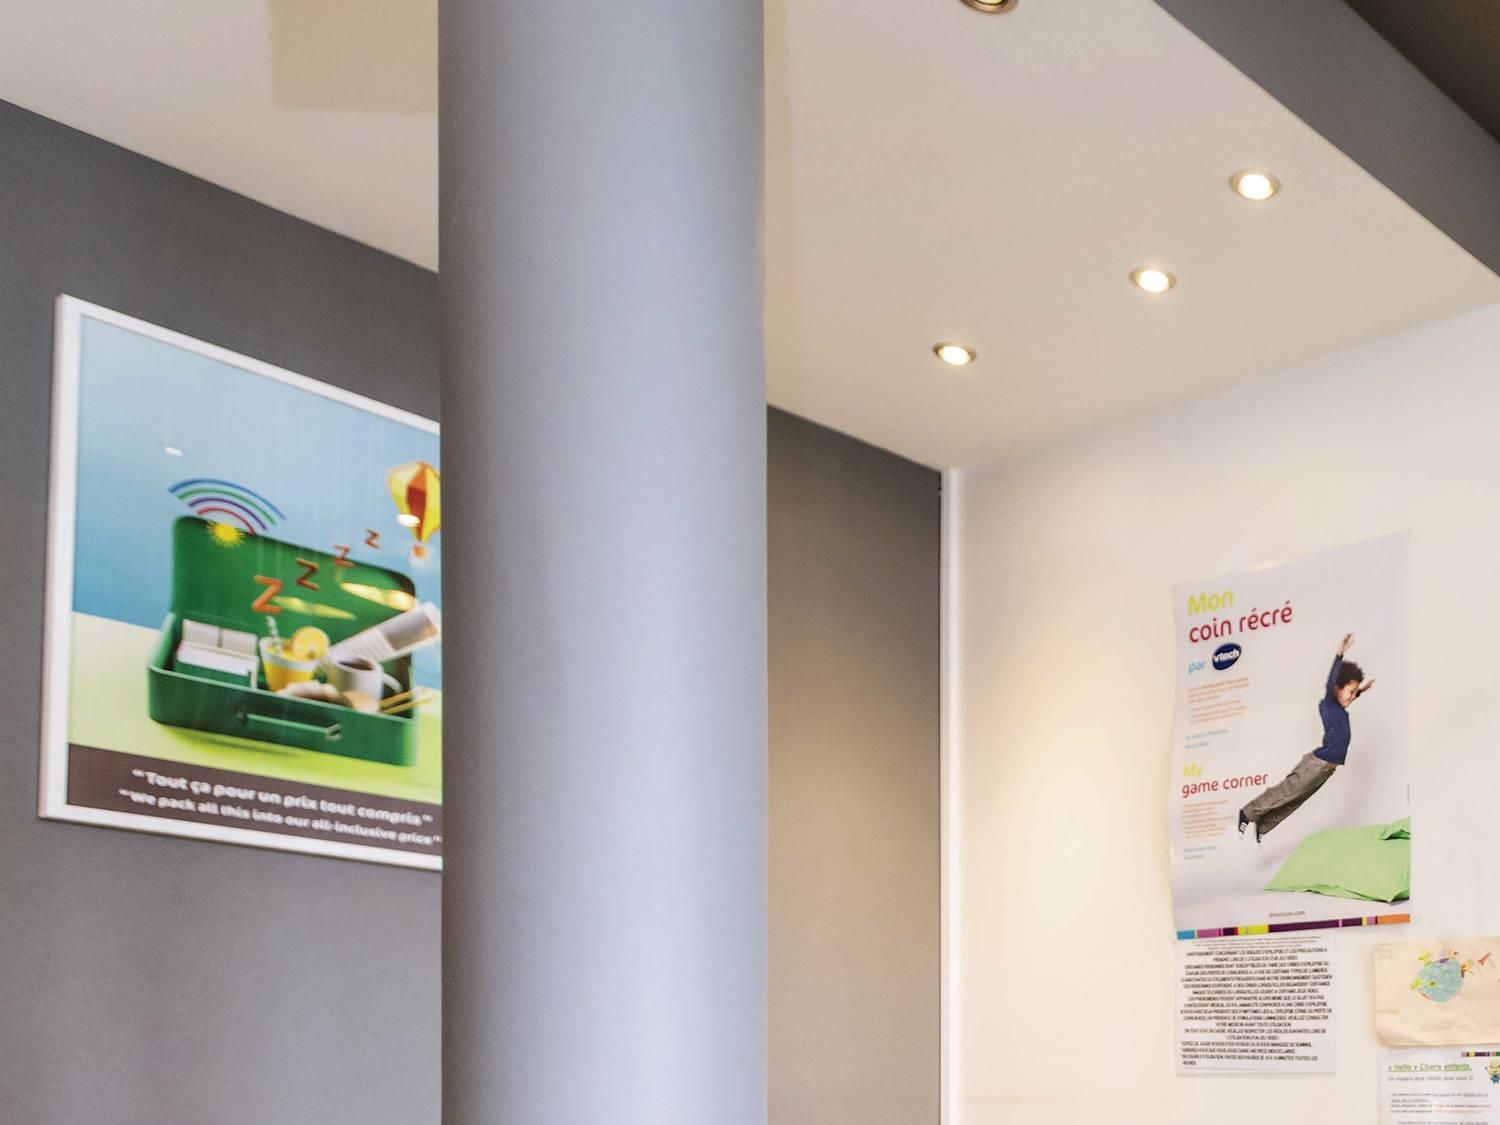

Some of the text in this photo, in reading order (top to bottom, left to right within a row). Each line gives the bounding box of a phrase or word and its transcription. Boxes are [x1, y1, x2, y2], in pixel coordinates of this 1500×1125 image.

[1187, 591, 1235, 616] Mon
[1188, 600, 1293, 644] coin récré
[1187, 660, 1207, 675] par
[189, 779, 213, 796] ça
[212, 783, 256, 802] pour
[257, 788, 283, 804] un
[283, 793, 318, 809] prix
[319, 798, 356, 817] tout
[1181, 774, 1269, 799] game corner
[157, 794, 196, 812] pack
[197, 800, 219, 816] all
[220, 803, 251, 820] this
[252, 808, 284, 825] into
[284, 814, 312, 828] our
